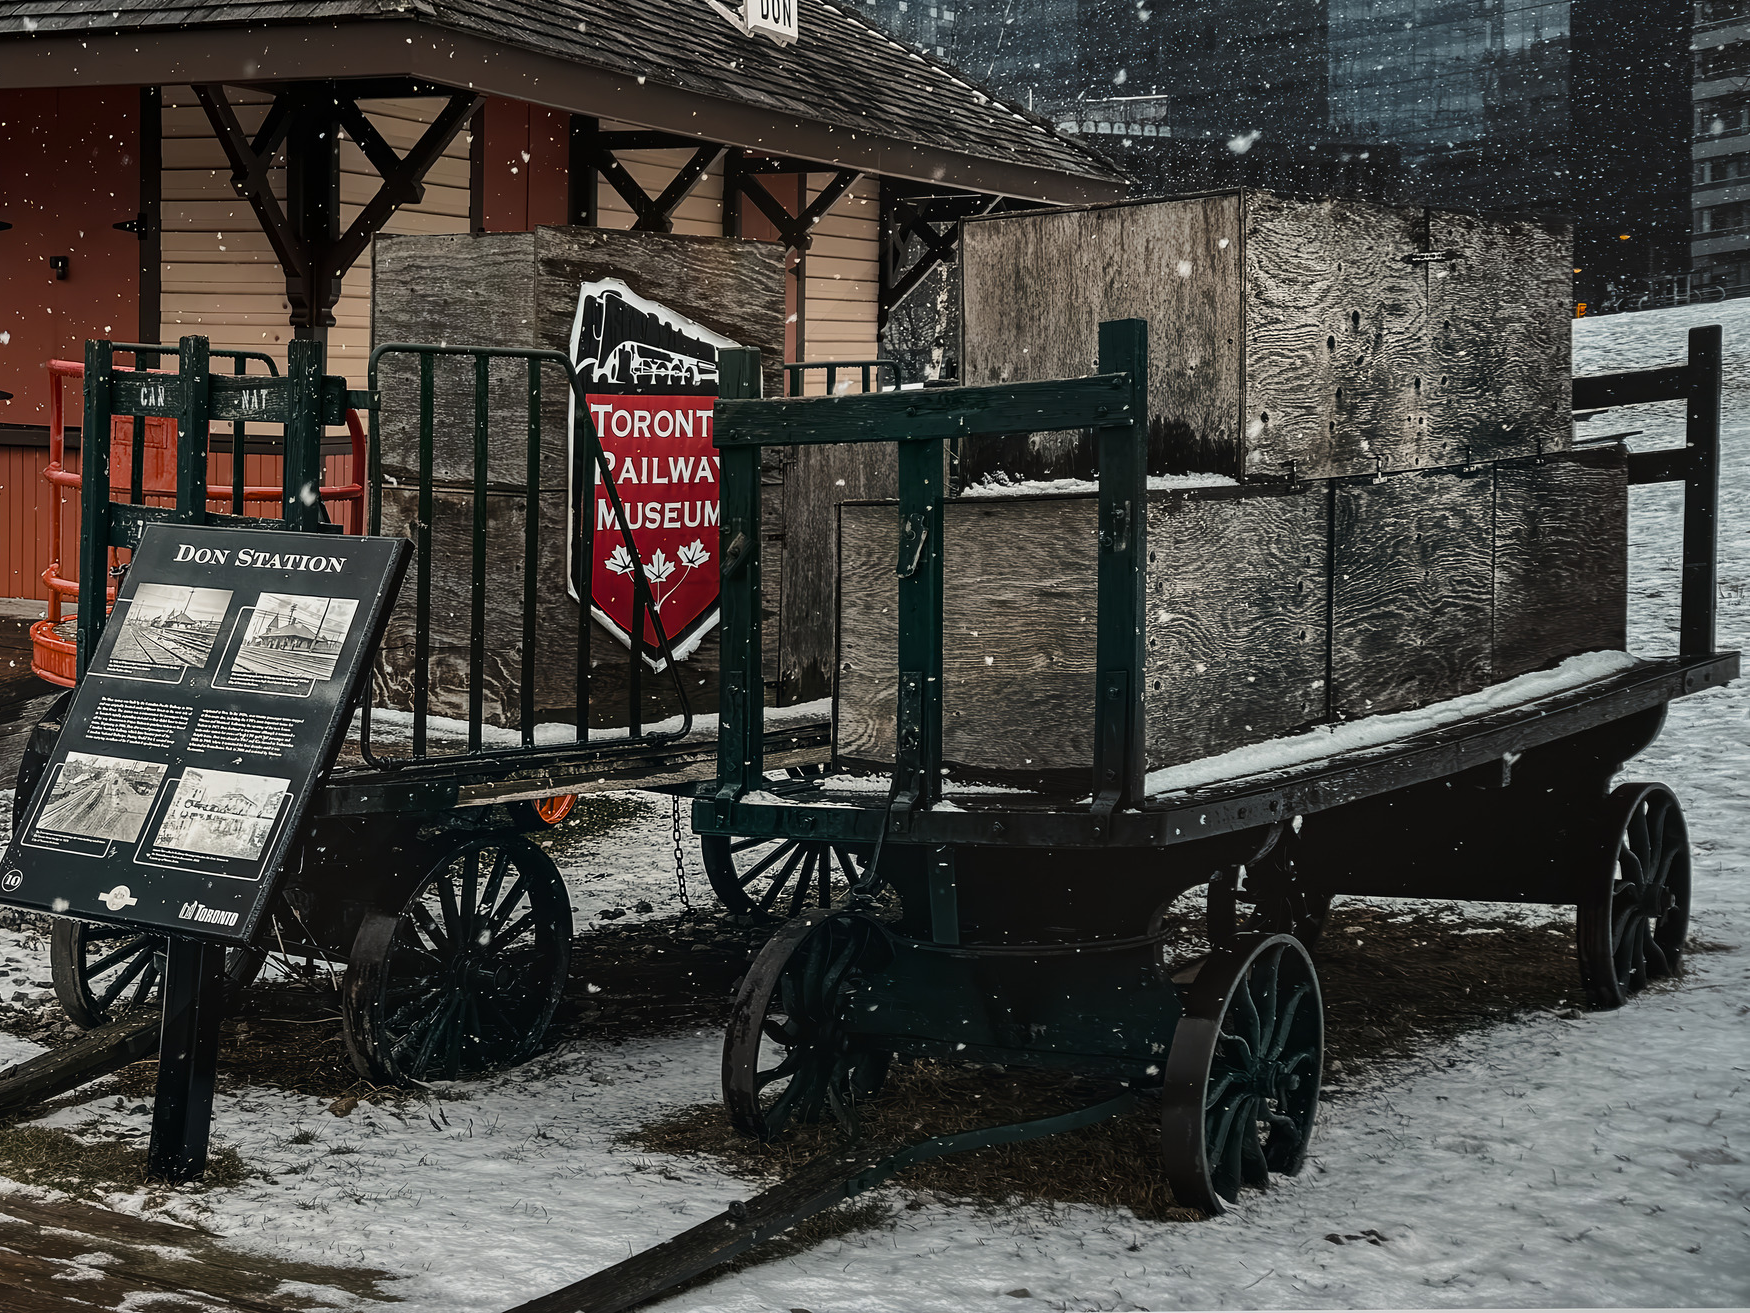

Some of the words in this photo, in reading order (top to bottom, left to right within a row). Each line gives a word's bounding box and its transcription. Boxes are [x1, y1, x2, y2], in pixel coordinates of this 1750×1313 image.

[241, 389, 268, 410] NAT
[590, 402, 714, 438] TORONT
[596, 498, 720, 531] MUSEUM
[173, 543, 231, 566] DON
[234, 548, 348, 574] STATION
[4, 873, 21, 887] 10
[193, 903, 240, 927] TORONTO
